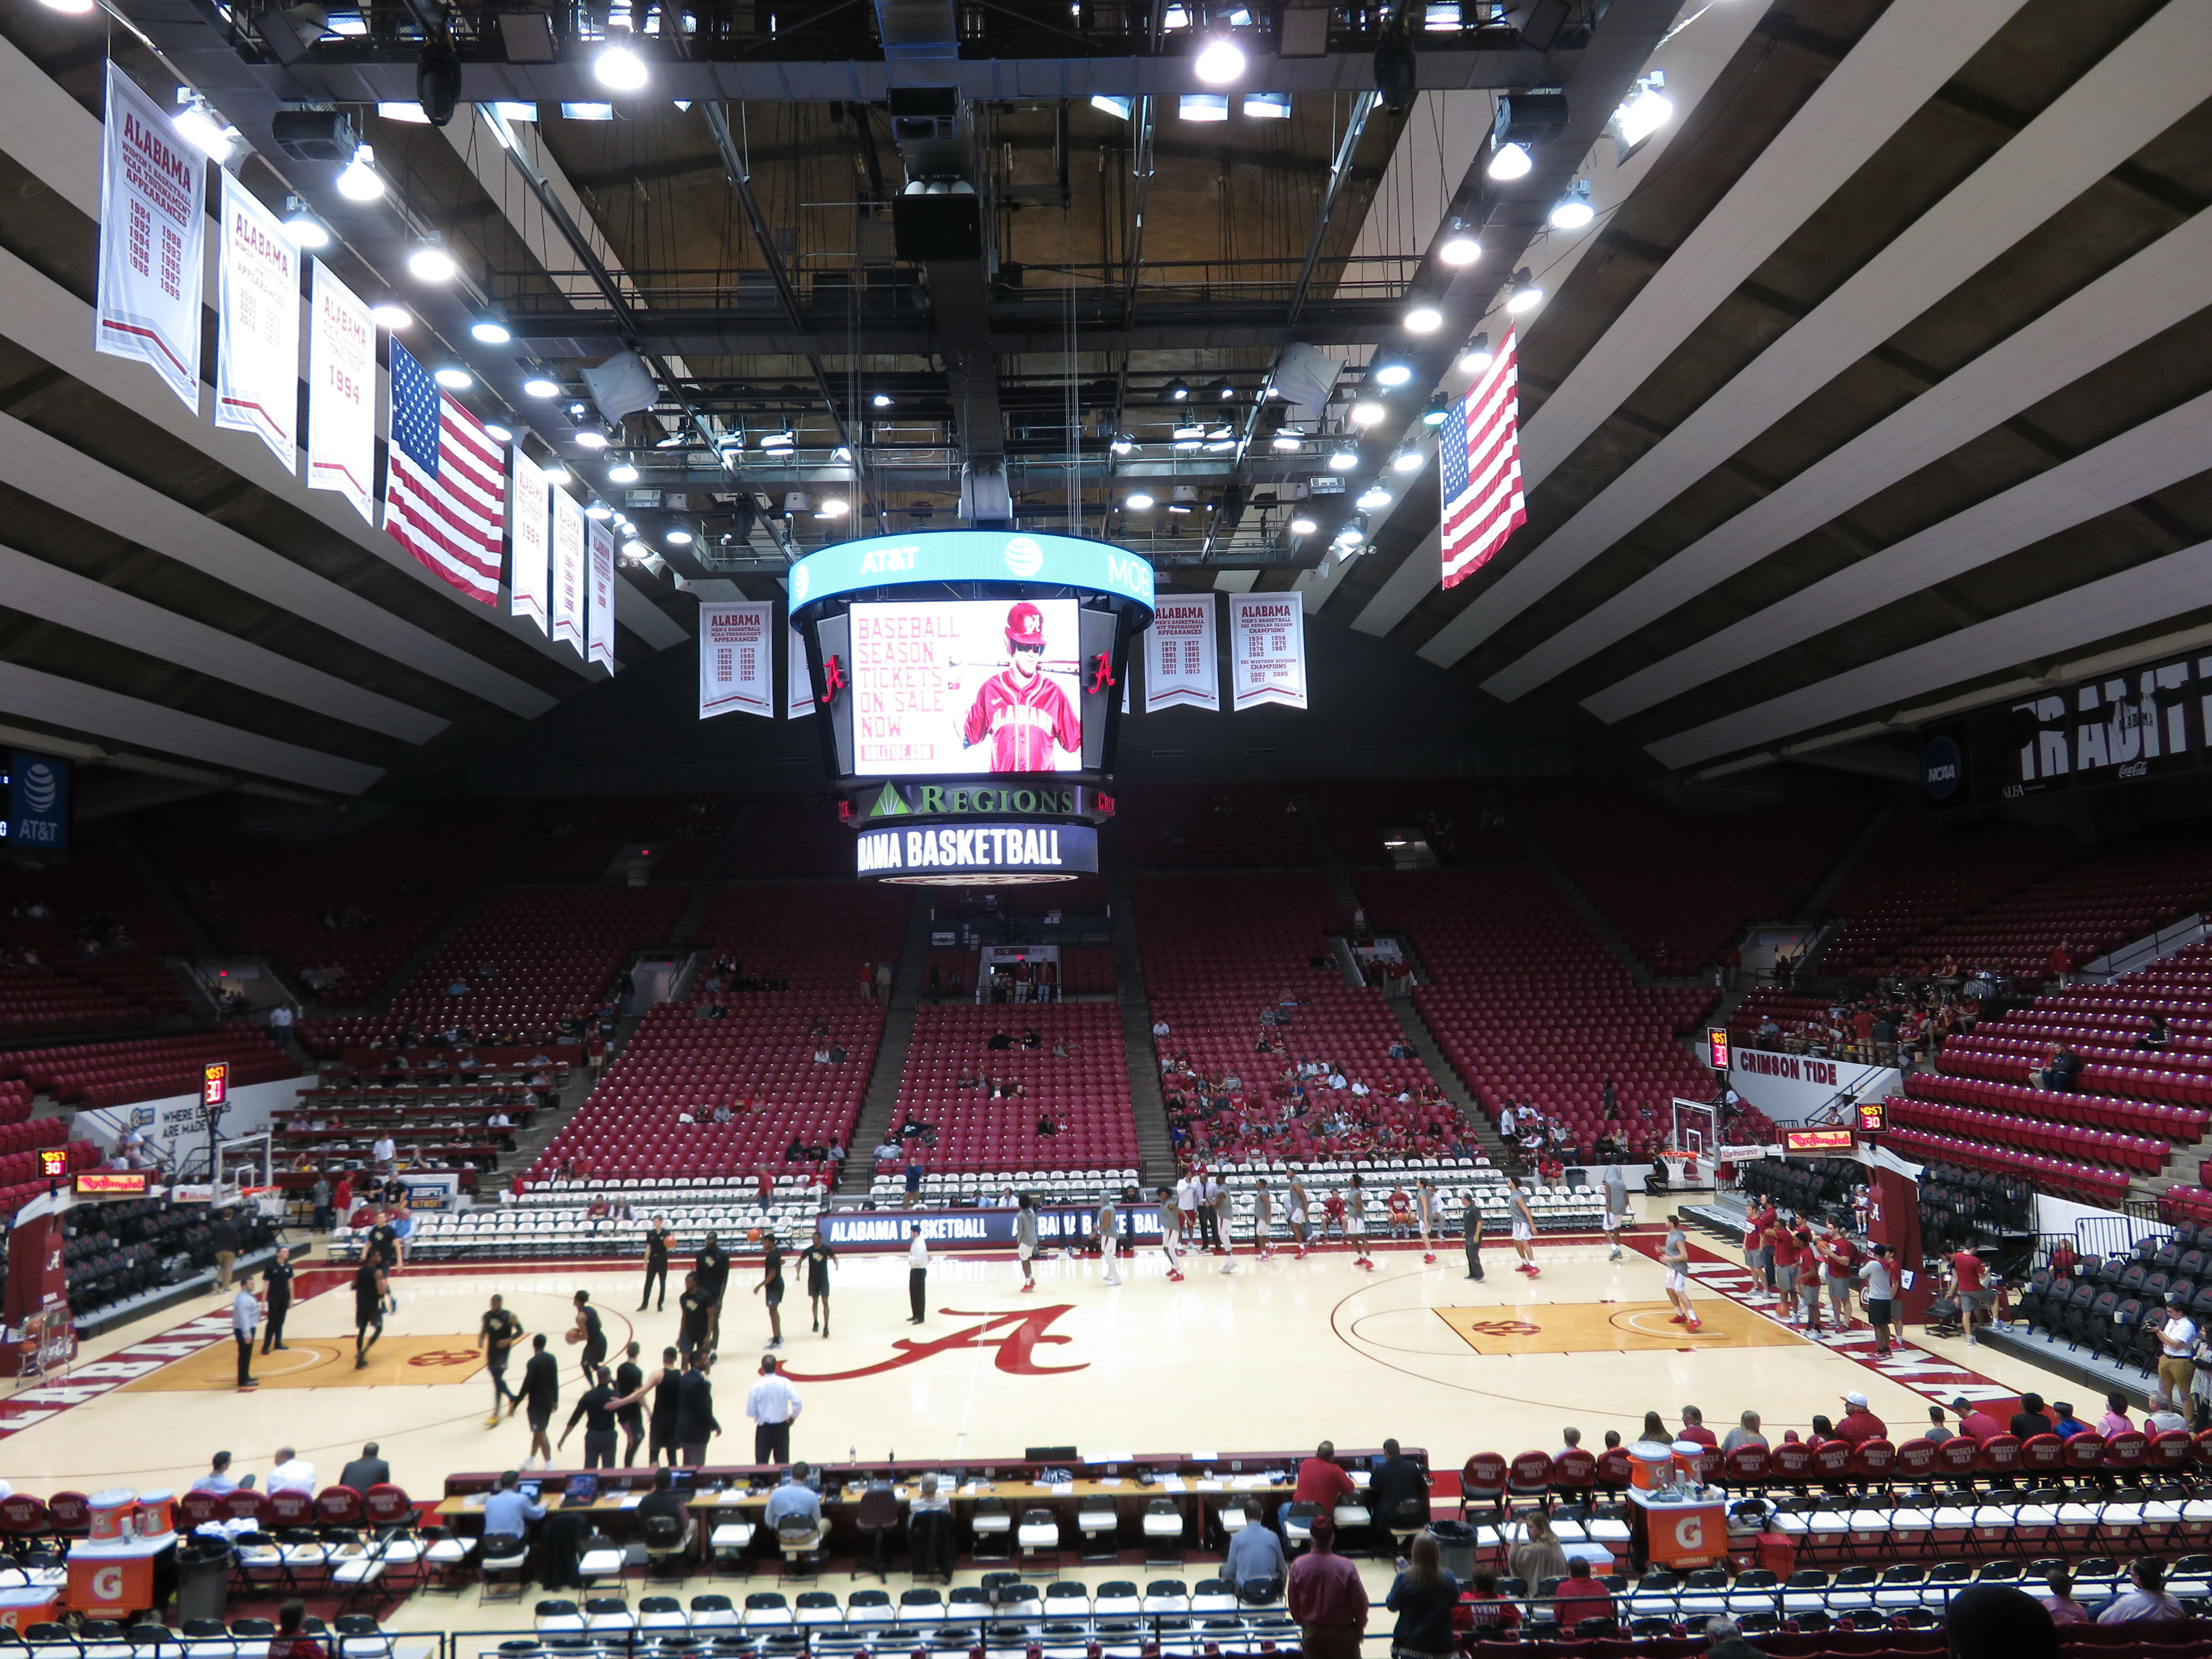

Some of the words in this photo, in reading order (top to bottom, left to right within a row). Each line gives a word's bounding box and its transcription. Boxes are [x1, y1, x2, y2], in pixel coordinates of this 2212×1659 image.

[124, 112, 191, 194] ALABAMA
[123, 152, 142, 175] NCAA
[144, 171, 191, 218] TOURNAMENT
[154, 168, 191, 207] BASKETBALL
[127, 168, 187, 228] APPEARANCES
[131, 199, 150, 223] 1984
[163, 226, 181, 249] 1988
[131, 212, 150, 237] 1992
[162, 239, 181, 262] 1993
[130, 226, 149, 251] 1994
[161, 252, 180, 275] 1995
[236, 212, 288, 277] ALABAMA
[129, 239, 149, 264] 1996
[161, 265, 180, 288] 1997
[130, 253, 148, 277] 1998
[161, 278, 179, 301] 1999
[241, 288, 256, 307] 2000
[241, 300, 256, 319] 2002
[325, 295, 366, 348] ALABAMA
[330, 365, 359, 405] 1994
[523, 521, 539, 547] 1994
[861, 547, 920, 575] AT&T
[1155, 607, 1203, 619] ALABAMA
[1242, 606, 1290, 617] ALABAMA
[712, 614, 760, 626] ALABAMA
[858, 617, 960, 639] BASEBALL
[859, 641, 934, 664] SEASON
[860, 666, 941, 688] TICKETS
[860, 692, 884, 713] ON
[895, 691, 943, 712] SALE
[862, 716, 901, 738] NOW
[1928, 765, 1955, 782] NCAA
[2002, 784, 2024, 798] ALFA
[920, 786, 1073, 814] REGIONS
[19, 819, 57, 841] AT&T
[907, 830, 1061, 867] BASKETBALL
[1715, 1045, 1727, 1066] 30
[1741, 1051, 1800, 1079] CRIMSON
[1803, 1060, 1837, 1086] TIDE
[207, 1080, 220, 1102] 30
[163, 1108, 193, 1123] WHERE
[1861, 1107, 1882, 1115] 40:57
[163, 1124, 180, 1138] ARE
[181, 1119, 207, 1134] MADE
[1866, 1117, 1880, 1128] 30
[41, 1152, 65, 1162] 40:57
[45, 1162, 61, 1175] 30
[830, 1220, 898, 1242] ALABAMA
[1946, 1446, 1976, 1457] MUSCLE
[1990, 1444, 2018, 1454] MUSCLE
[2032, 1444, 2061, 1453] MUSCLE
[2074, 1442, 2103, 1451] MUSCLE
[2115, 1441, 2145, 1450] MUSCLE
[2159, 1441, 2189, 1449] MUSCLE
[1736, 1454, 1765, 1462] MUSCLE
[1780, 1452, 1809, 1461] MUSCLE
[1820, 1449, 1849, 1460] MUSCLE
[1864, 1449, 1893, 1459] MUSCLE
[1904, 1447, 1934, 1459] MUSCLE
[1953, 1454, 1972, 1463] MILK
[1995, 1453, 2013, 1462] MILK
[2036, 1452, 2054, 1460] MILK
[2077, 1449, 2096, 1459] MILK
[2121, 1449, 2139, 1458] MILK
[2165, 1448, 2183, 1457] MILK
[1473, 1462, 1501, 1471] MUSCLE
[1518, 1460, 1547, 1470] MUSCLE
[1564, 1459, 1592, 1469] MUSCLE
[1741, 1462, 1760, 1471] MILK
[1784, 1460, 1803, 1469] MILK
[1827, 1458, 1845, 1468] MILK
[1868, 1457, 1886, 1466] MILK
[1911, 1456, 1929, 1465] MILK
[1567, 1468, 1586, 1477] MILK
[1656, 1467, 1665, 1478] G
[1676, 1516, 1702, 1548] G
[1676, 1557, 1709, 1565] GATORADE
[93, 1567, 122, 1599] G
[1472, 1605, 1501, 1614] EVENT
[1, 1611, 17, 1627] G
